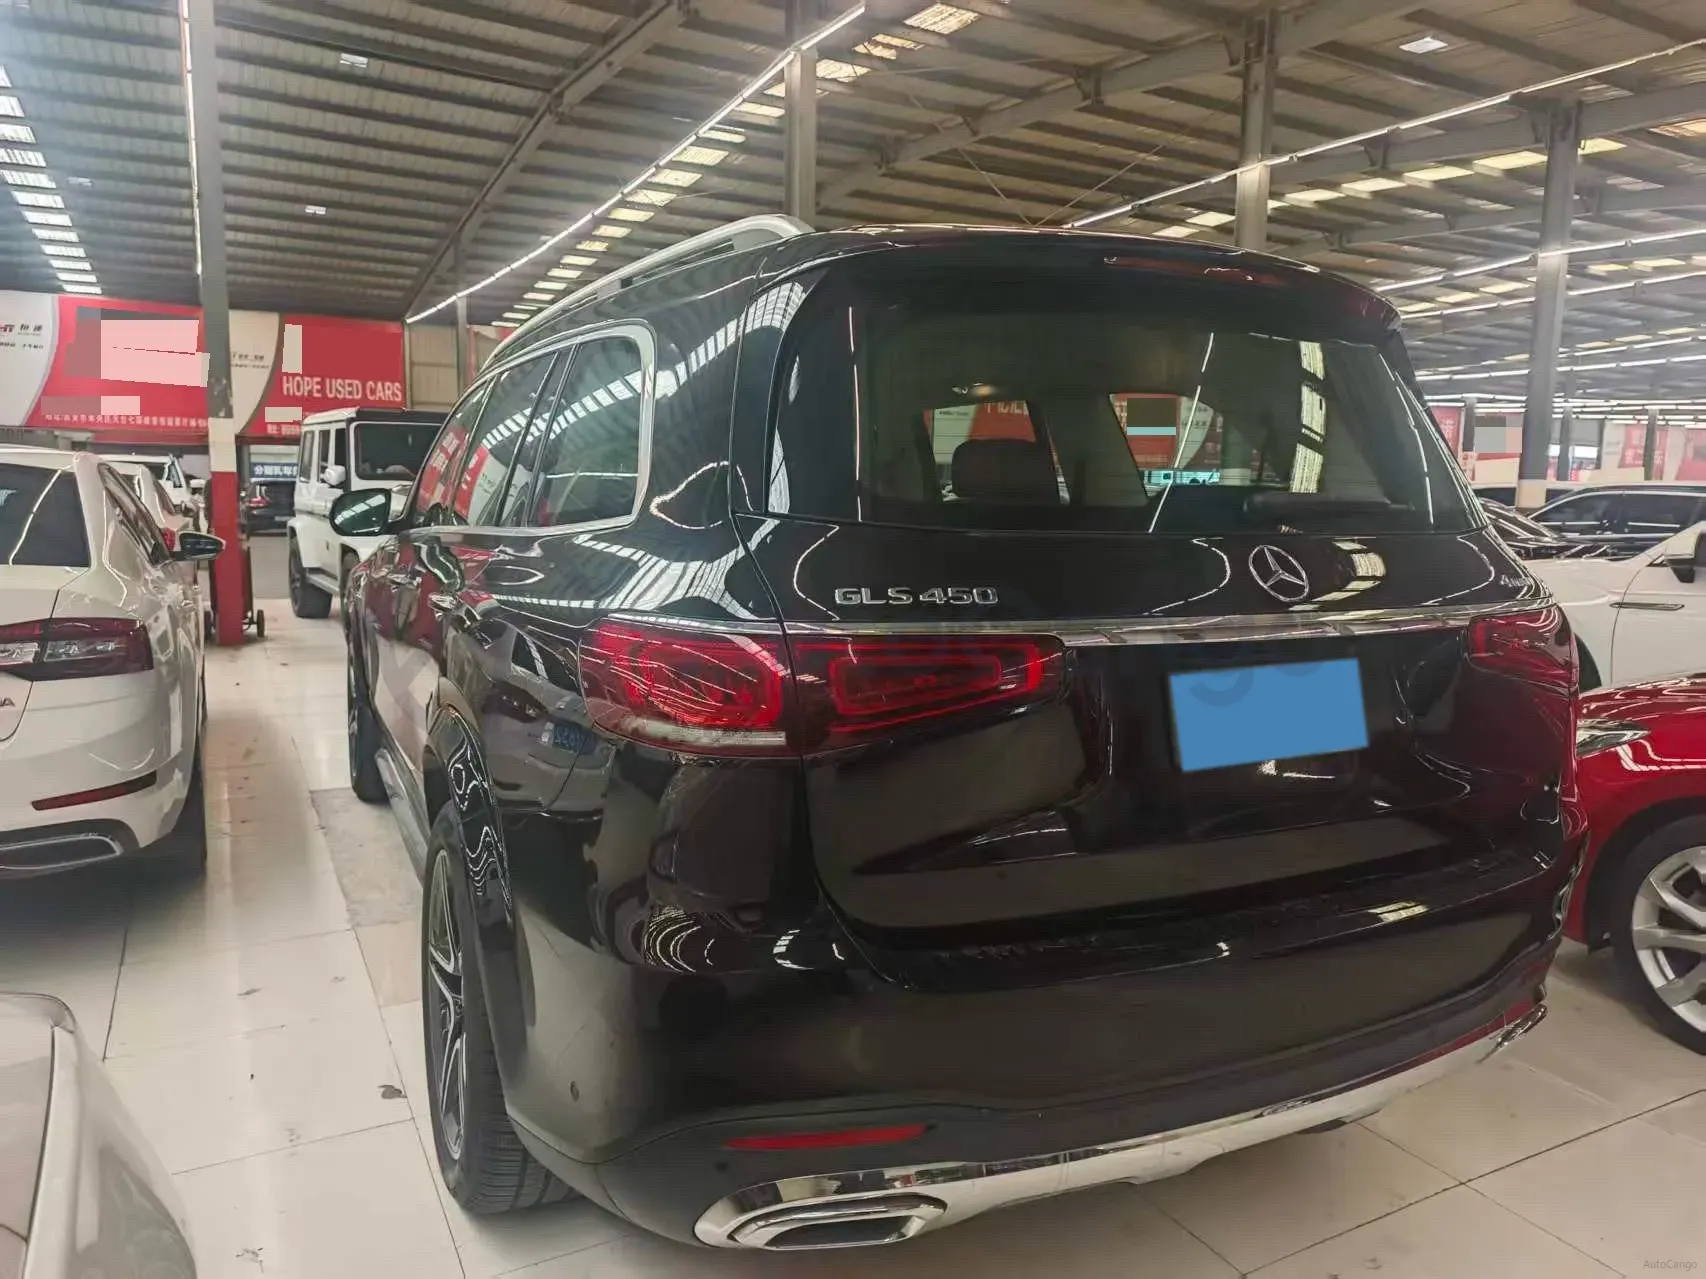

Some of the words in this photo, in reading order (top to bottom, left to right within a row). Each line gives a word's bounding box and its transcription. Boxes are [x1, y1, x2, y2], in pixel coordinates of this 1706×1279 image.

[282, 376, 322, 397] HOPE
[325, 378, 362, 399] USED
[366, 381, 402, 402] CARS
[834, 586, 914, 605] GLS
[919, 586, 1000, 605] 450
